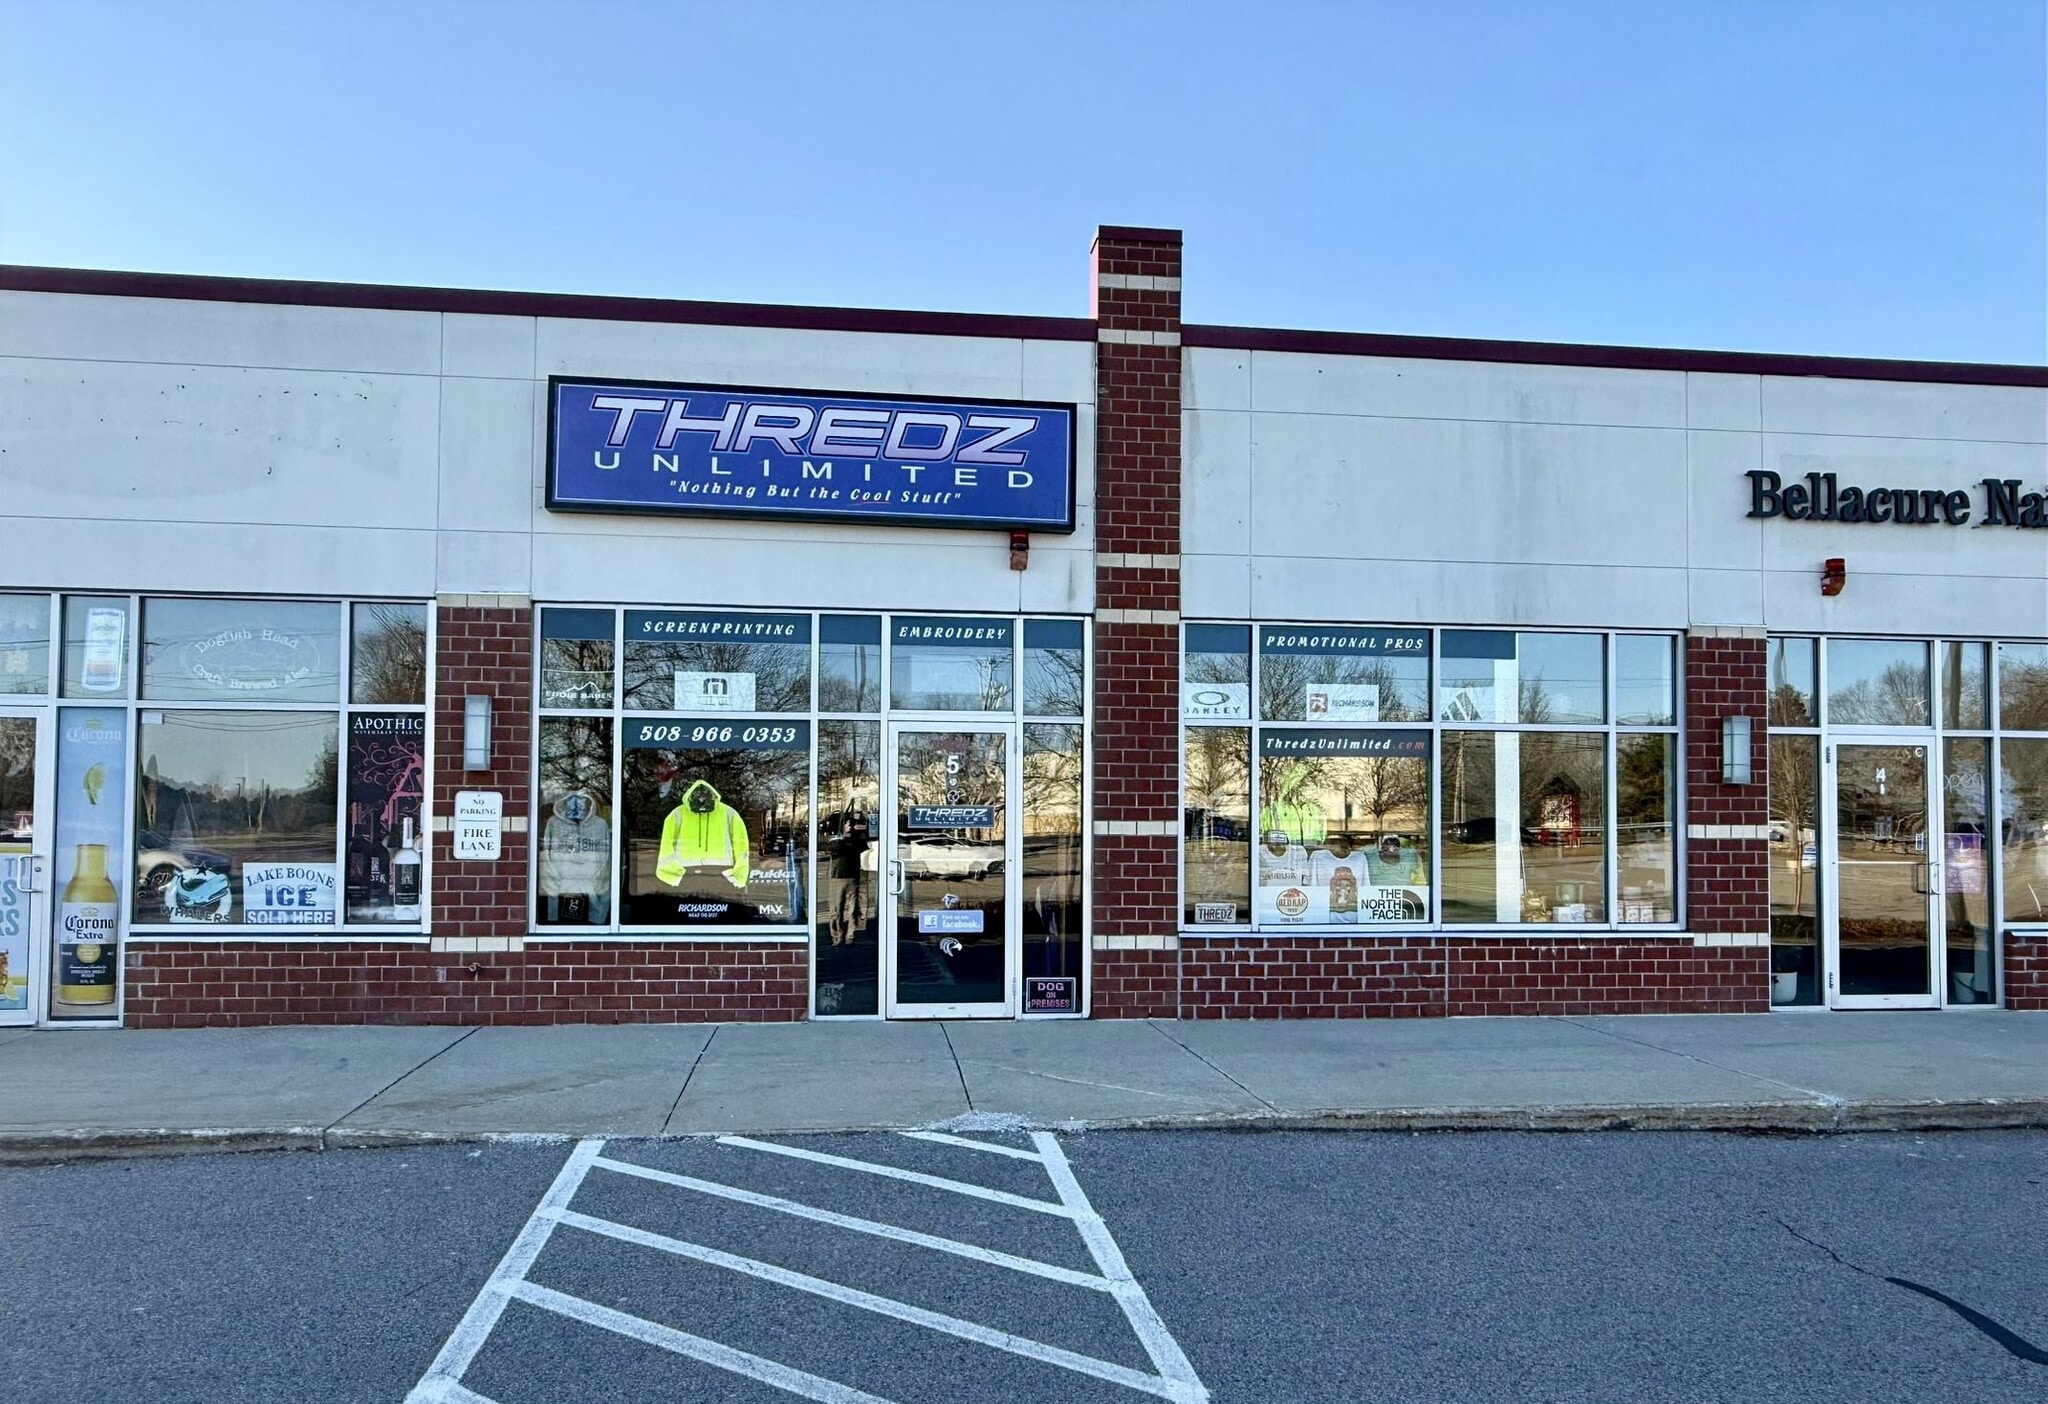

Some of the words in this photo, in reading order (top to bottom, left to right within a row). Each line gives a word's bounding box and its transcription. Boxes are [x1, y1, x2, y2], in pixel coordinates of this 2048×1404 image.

[589, 393, 1040, 467] THREDZ
[594, 451, 1033, 488] UNLIMITED
[670, 480, 756, 498] "Nothing
[767, 484, 800, 498] But
[810, 487, 839, 499] the
[850, 488, 891, 502] Cool
[901, 490, 961, 504] Stuff"
[1745, 470, 1970, 526] Bellacure
[1979, 478, 2048, 528] Na
[643, 621, 795, 636] SCREENPRINTING
[899, 626, 1006, 639] EMBROIDERY
[1266, 636, 1376, 648] PROMOTIONAL
[1385, 638, 1423, 649] PROS
[354, 717, 423, 730] APOTHIC
[640, 726, 796, 743] 508-966-0353
[1266, 738, 1425, 750] ThredzUnlimited.com
[946, 755, 960, 774] 5
[915, 808, 988, 817] THREDZ
[464, 829, 493, 838] FIRE
[461, 841, 494, 851] LANE
[247, 869, 283, 886] LAKE
[287, 867, 335, 888] BOONE
[265, 884, 318, 907] ICE
[1379, 889, 1401, 898] THE
[678, 904, 728, 912] RICHARDSON
[759, 904, 783, 914] MAX
[1361, 899, 1401, 909] NORTH
[161, 905, 231, 922] WHALERS
[247, 911, 286, 923] SOLD
[295, 911, 333, 923] HERE
[1199, 908, 1233, 920] THREDZ
[1372, 910, 1401, 919] FACE
[65, 915, 114, 932] Corona
[76, 930, 103, 939] Extra
[1037, 982, 1064, 991] DOG
[1031, 999, 1070, 1008] PREMISES
